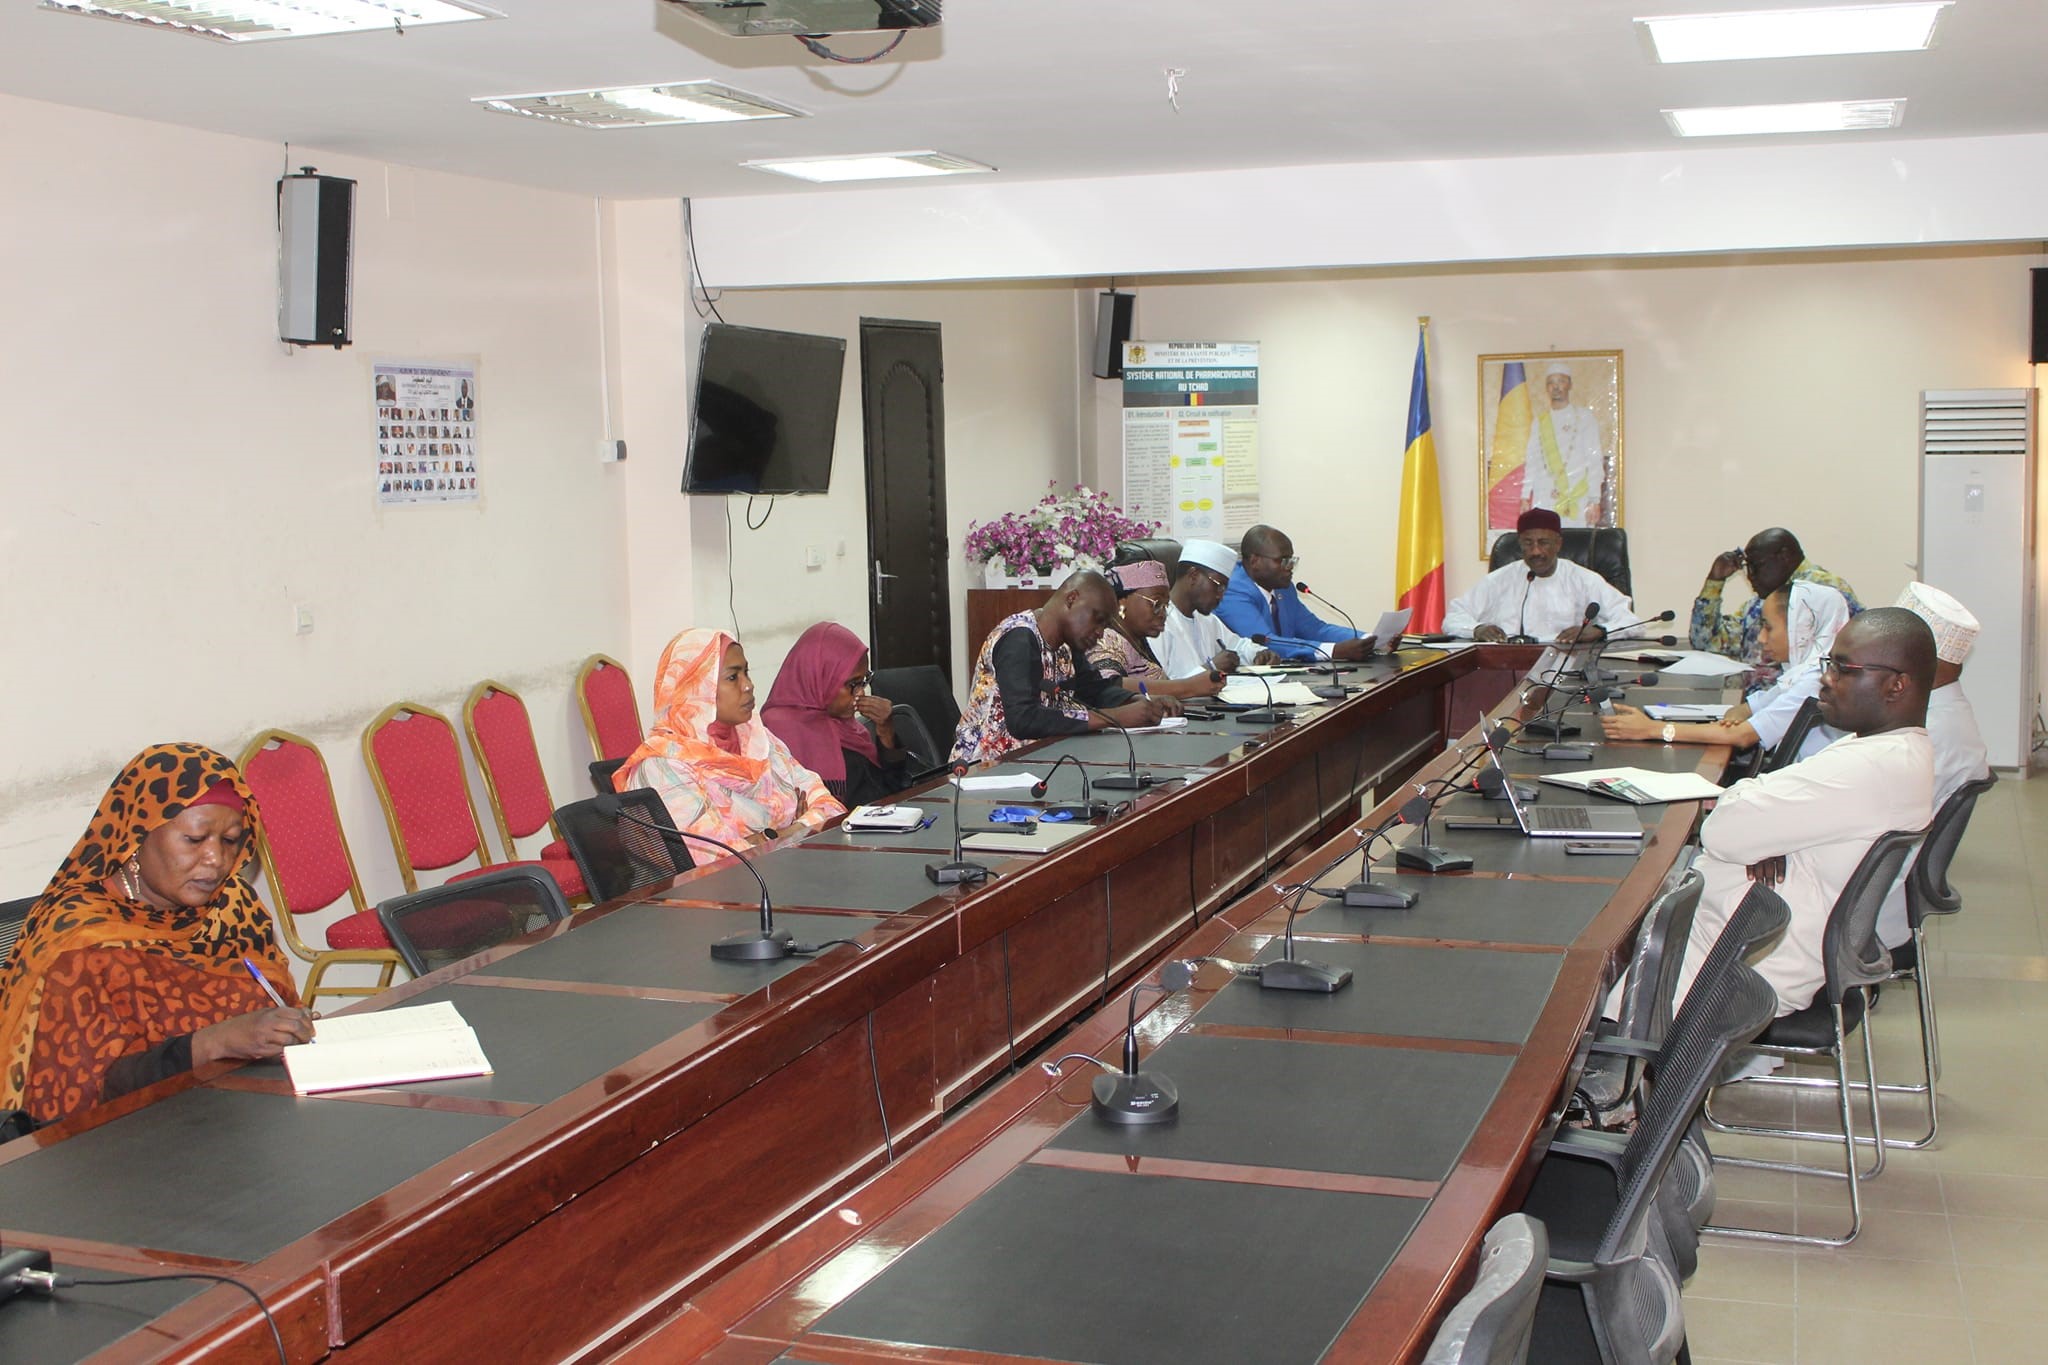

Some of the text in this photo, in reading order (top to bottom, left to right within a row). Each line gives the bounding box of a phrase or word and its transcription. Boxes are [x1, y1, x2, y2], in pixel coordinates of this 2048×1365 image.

[1155, 371, 1184, 380] NATIONAL
[1185, 371, 1194, 379] DE
[1195, 370, 1257, 379] PHARMACOVIGILANCE
[1178, 382, 1209, 391] AU TCHAD
